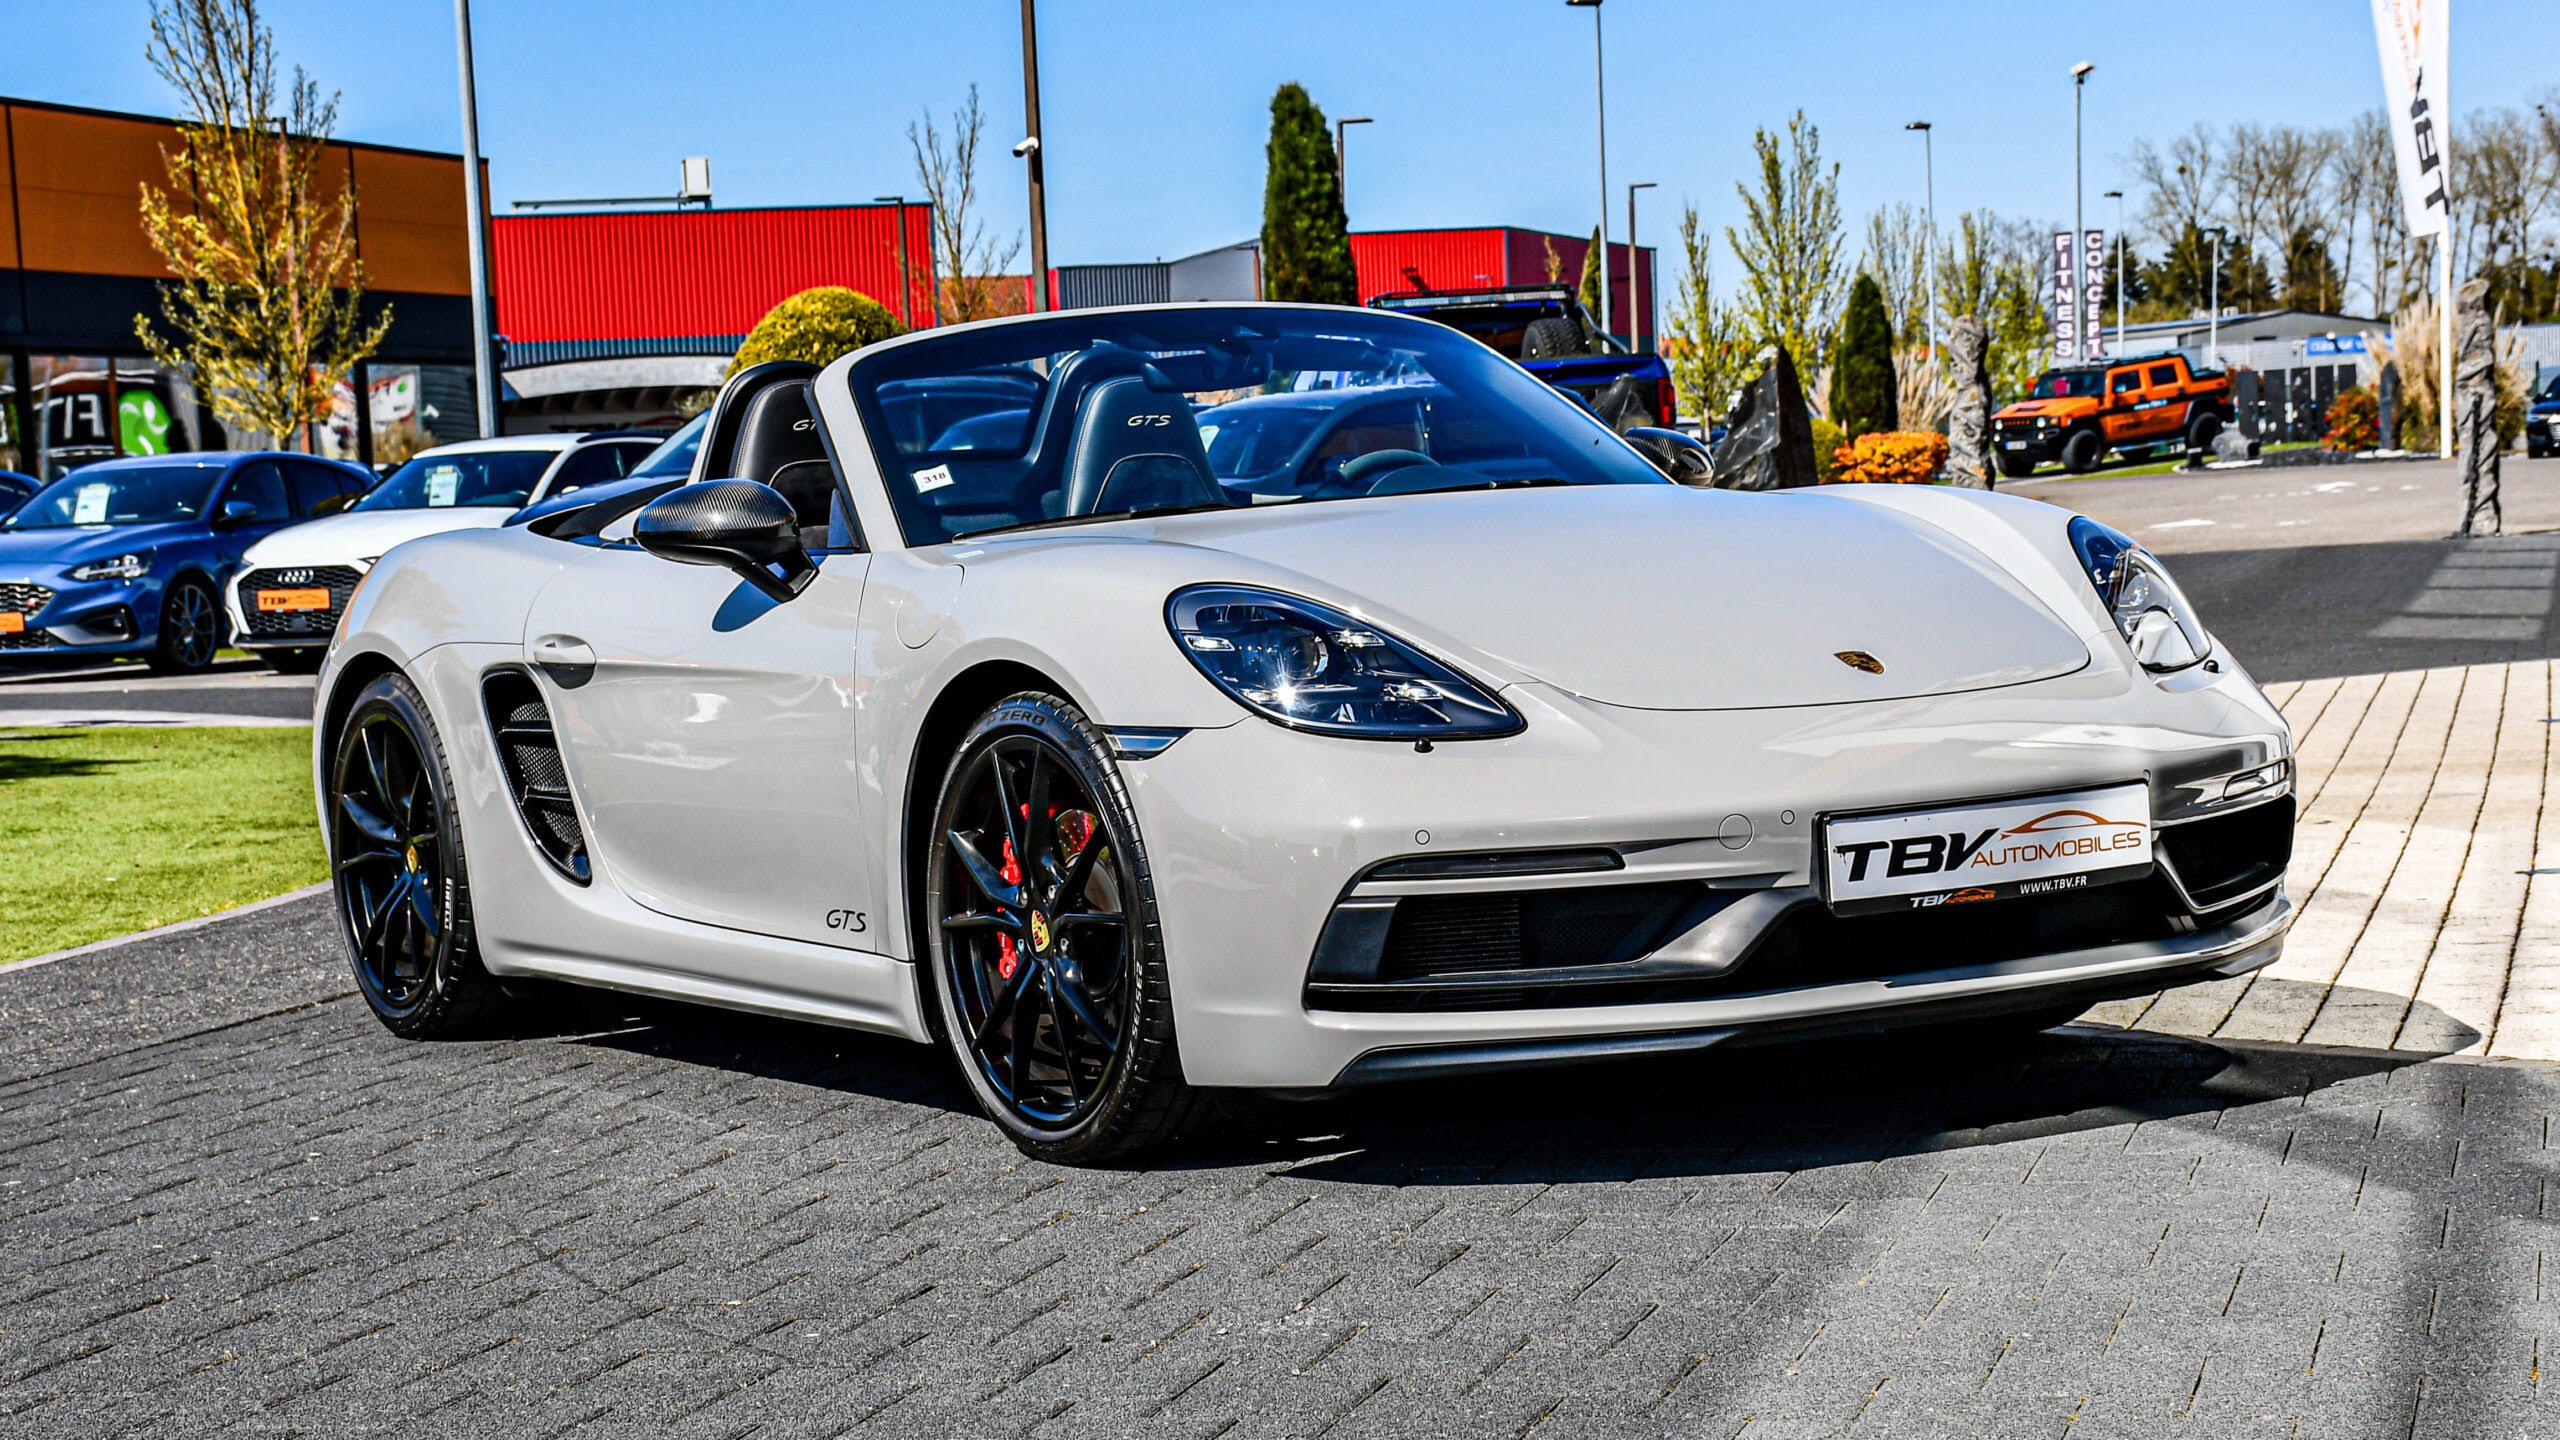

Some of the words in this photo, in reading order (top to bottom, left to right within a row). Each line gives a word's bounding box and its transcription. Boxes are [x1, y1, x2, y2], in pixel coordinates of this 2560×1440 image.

[2055, 234, 2074, 357] FITNESS
[2085, 232, 2103, 354] CONCEPT
[1127, 414, 1171, 426] GTS
[923, 472, 947, 484] 318
[1000, 709, 1046, 726] ZERO
[1834, 827, 2000, 882] TBV
[1970, 831, 2142, 868] AUTOMOBILES
[2019, 875, 2087, 895] WWW.TBV.FR
[1910, 893, 1953, 908] TBV
[825, 909, 867, 932] GTS
[1131, 960, 1143, 1039] 235/35
